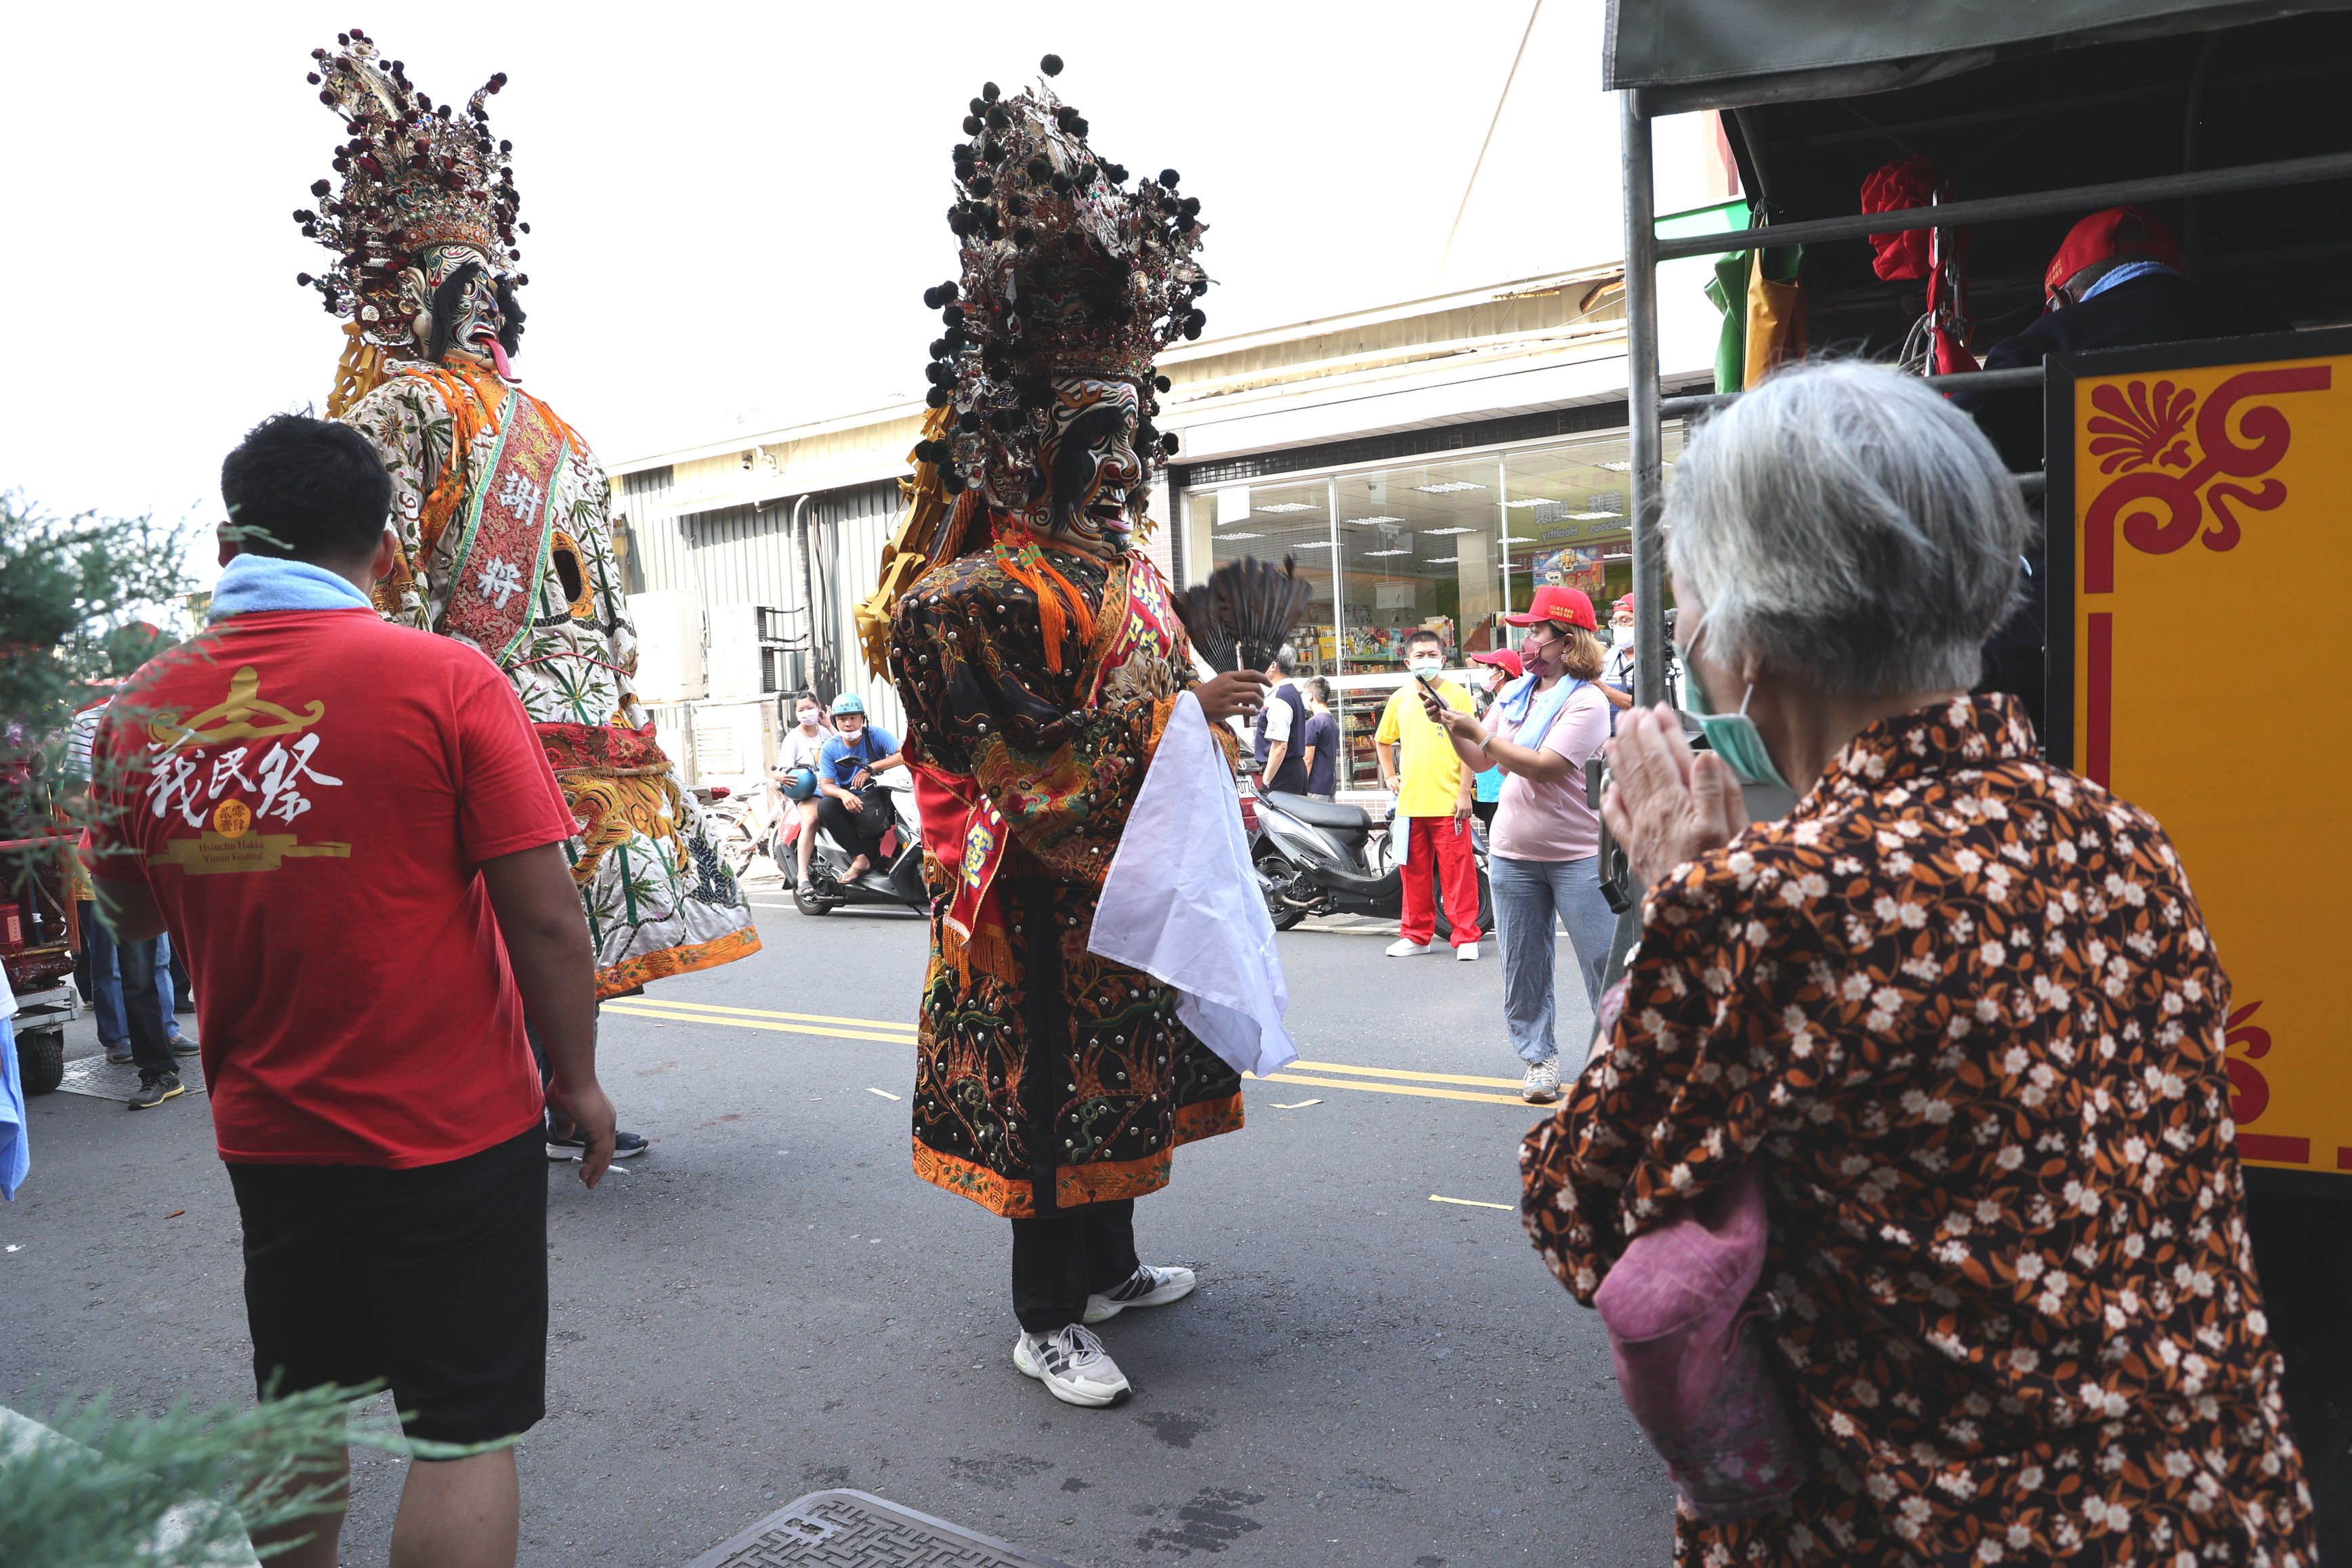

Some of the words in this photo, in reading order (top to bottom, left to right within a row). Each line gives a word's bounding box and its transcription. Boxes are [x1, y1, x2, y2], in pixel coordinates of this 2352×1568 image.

[146, 729, 343, 828] 義民祭
[199, 842, 235, 852] Hsinchu
[238, 840, 264, 849] Hakka
[202, 853, 230, 864] Yimin
[232, 851, 263, 862] Festival
